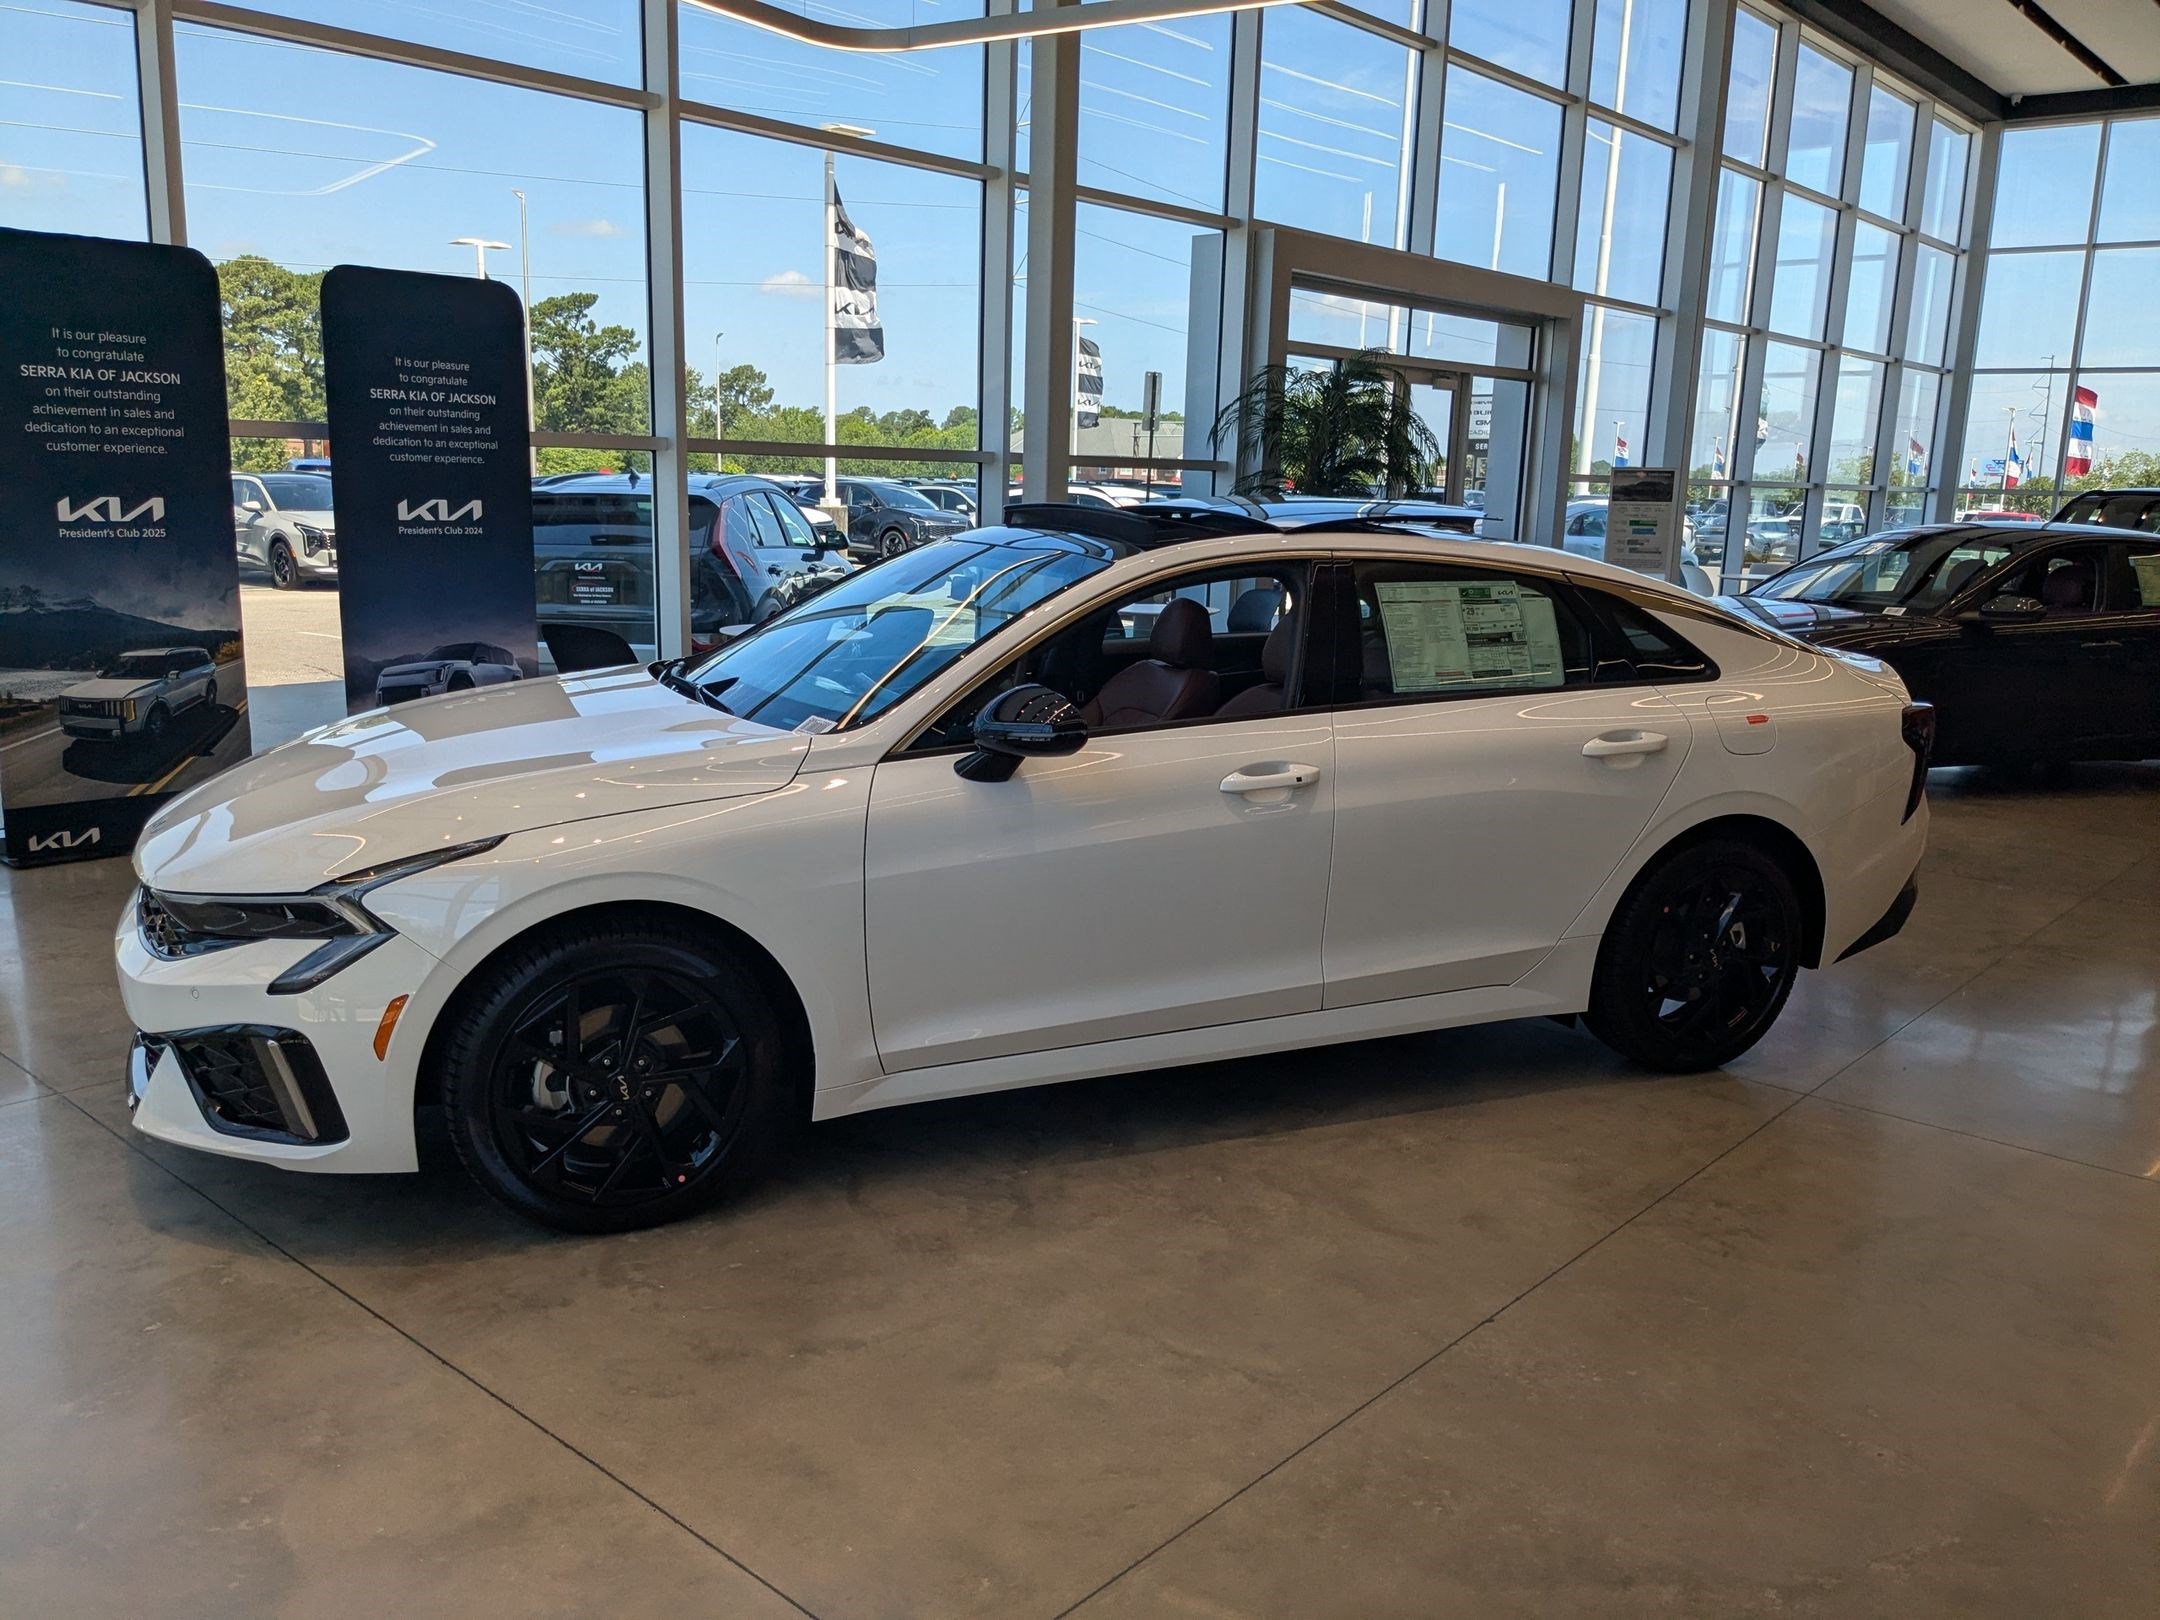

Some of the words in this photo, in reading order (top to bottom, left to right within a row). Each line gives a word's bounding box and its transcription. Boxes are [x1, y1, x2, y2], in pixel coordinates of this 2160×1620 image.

[52, 327, 60, 339] It
[64, 328, 72, 340] is
[76, 331, 95, 341] our
[99, 331, 147, 345] pleasure
[57, 348, 69, 358] to
[72, 348, 144, 362] congratulate
[395, 356, 402, 367] It
[404, 358, 412, 368] is
[414, 360, 429, 368] our
[432, 360, 470, 371] pleasure
[20, 364, 67, 379] SERRA
[70, 368, 94, 380] KIA
[98, 369, 117, 381] OF
[120, 370, 181, 385] JACKSON
[399, 373, 408, 382] to
[410, 374, 468, 386] congratulate
[45, 387, 60, 396] on
[64, 386, 90, 398] their
[94, 388, 161, 404] outstanding
[370, 388, 406, 400] SERRA
[409, 390, 428, 402] KIA
[430, 392, 446, 402] OF
[448, 393, 496, 405] JACKSON
[32, 404, 107, 418] achievement
[110, 406, 120, 418] in
[124, 408, 152, 419] sales
[154, 409, 175, 420] and
[389, 407, 401, 416] on
[404, 406, 424, 416] their
[428, 408, 480, 421] outstanding
[25, 422, 86, 434] dedication
[90, 424, 102, 434] to
[104, 426, 118, 436] an
[122, 426, 184, 438] exceptional
[379, 421, 438, 432] achievement
[440, 424, 448, 433] in
[450, 424, 472, 434] sales
[474, 426, 491, 435] and
[46, 441, 100, 452] customer
[104, 442, 168, 455] experience.
[373, 436, 422, 446] dedication
[424, 438, 433, 447] to
[436, 440, 446, 448] an
[448, 440, 498, 451] exceptional
[390, 453, 432, 462] customer
[434, 454, 485, 464] experience.
[57, 496, 165, 522] KIA
[398, 498, 482, 521] KIA
[59, 528, 114, 538] President's
[116, 528, 140, 538] Club
[142, 528, 166, 538] 2025
[398, 526, 442, 535] President's
[444, 526, 462, 535] Club
[464, 527, 483, 535] 2024
[575, 562, 602, 571] KIA
[28, 827, 101, 852] KIA
